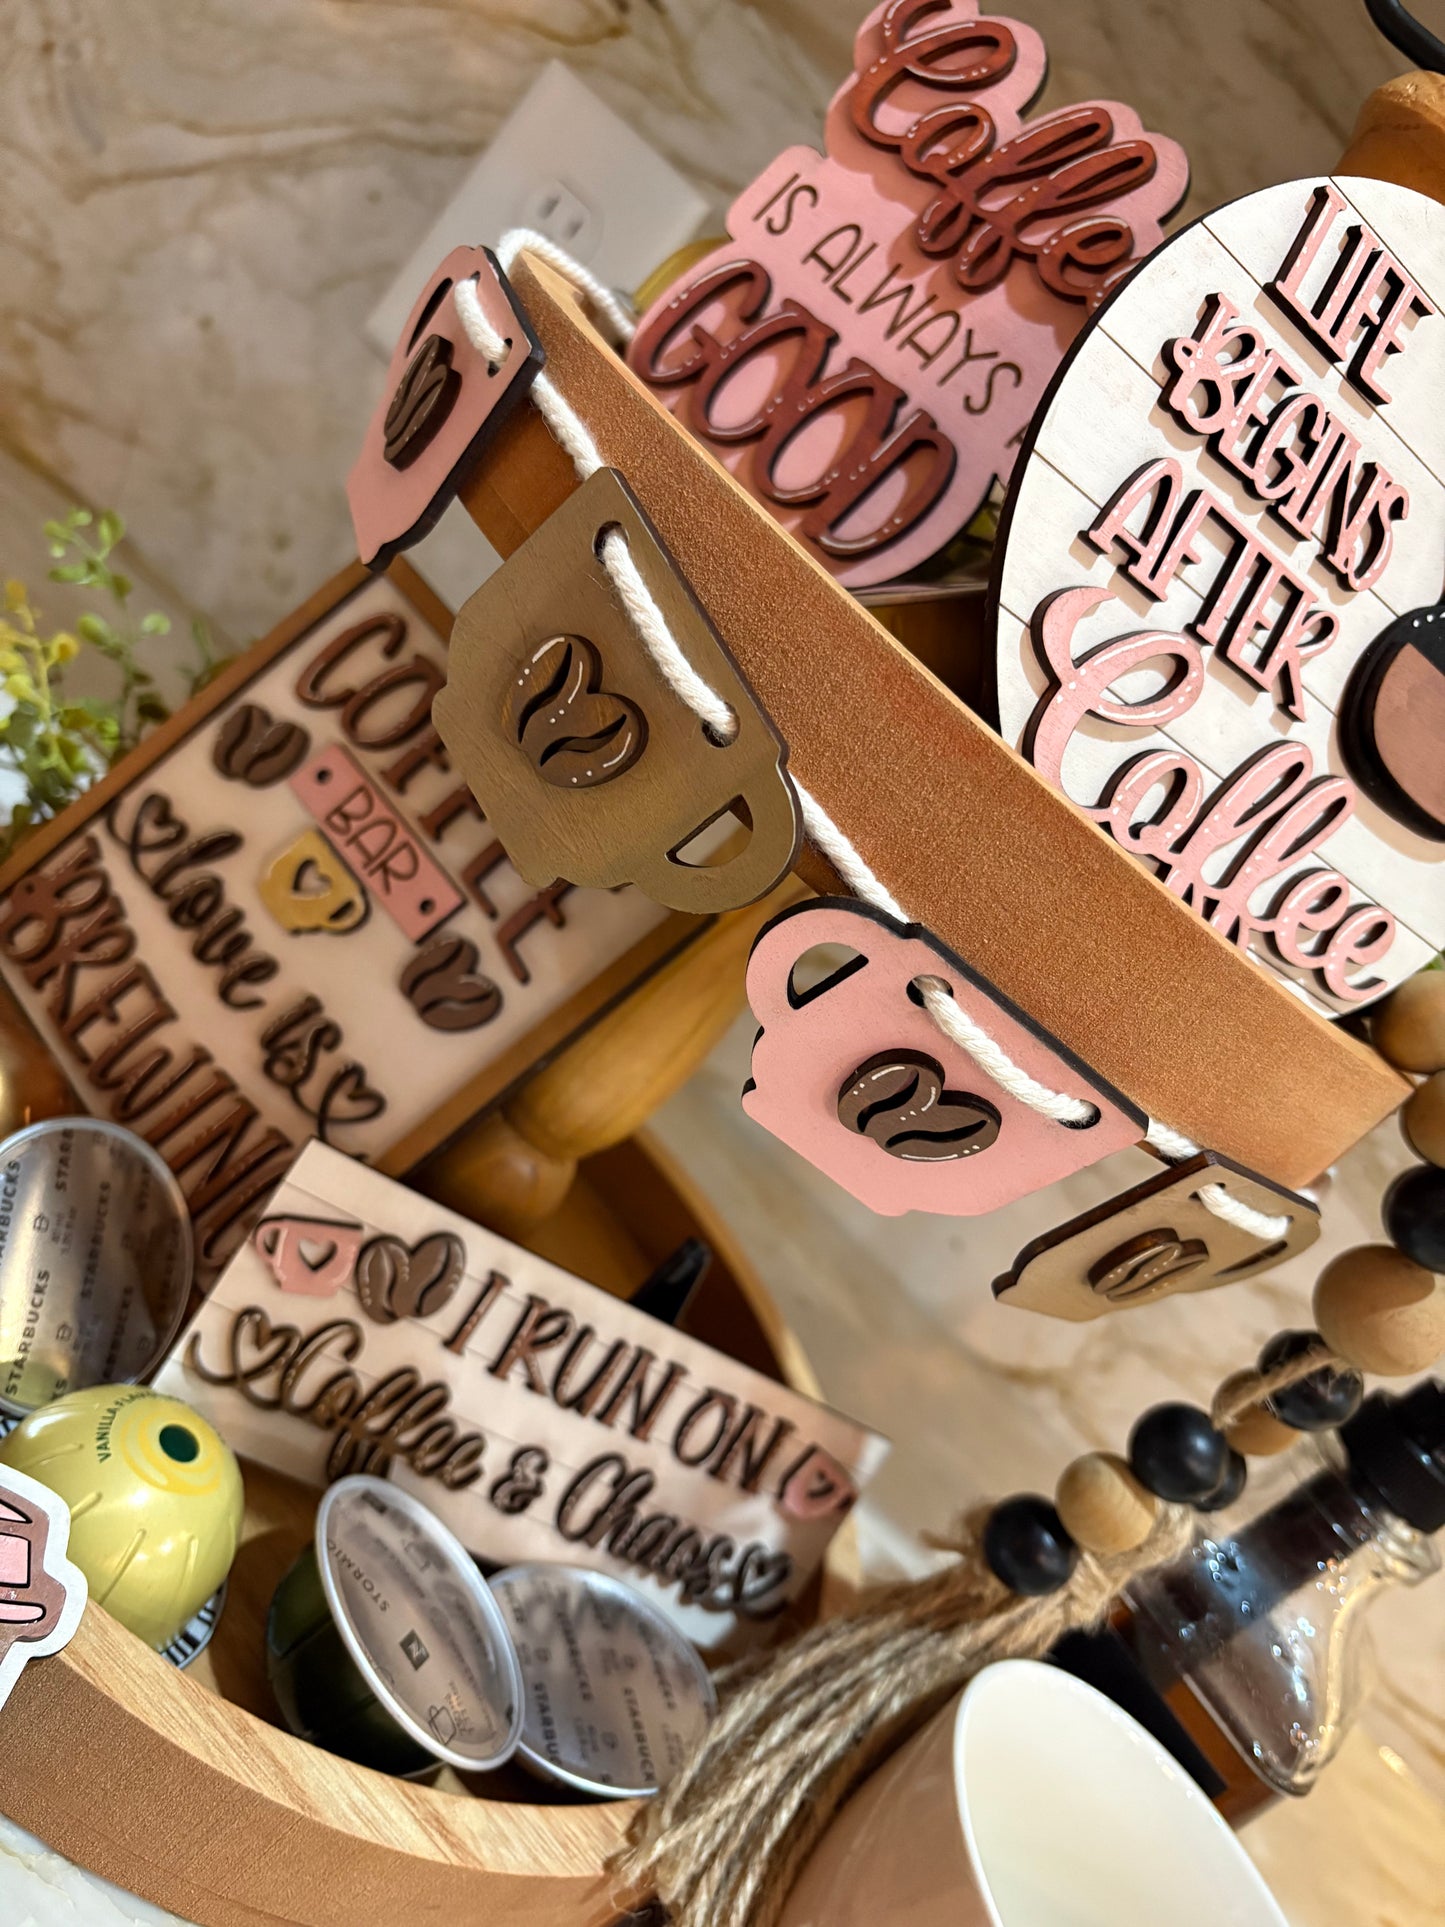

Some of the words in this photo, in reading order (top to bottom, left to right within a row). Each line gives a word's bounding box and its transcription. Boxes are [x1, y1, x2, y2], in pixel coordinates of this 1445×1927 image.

[630, 259, 957, 555] GOOD
[753, 172, 817, 236] IS
[802, 223, 1023, 416] ALWAYS
[1264, 184, 1437, 406] LIFE
[1162, 291, 1410, 594] BEGINS
[1080, 456, 1341, 724] AFTER
[324, 785, 422, 896] BAR
[1023, 585, 1398, 1001] Coffee
[150, 832, 281, 1011] love
[5, 1269, 50, 1396] STARBUCKS
[96, 1408, 117, 1463] VANILLA
[443, 1268, 511, 1356] I
[487, 1294, 690, 1443] RUN
[671, 1385, 797, 1496] ON
[279, 1319, 487, 1492] Coffee
[488, 1446, 549, 1514] &
[556, 1453, 738, 1612] Chaos
